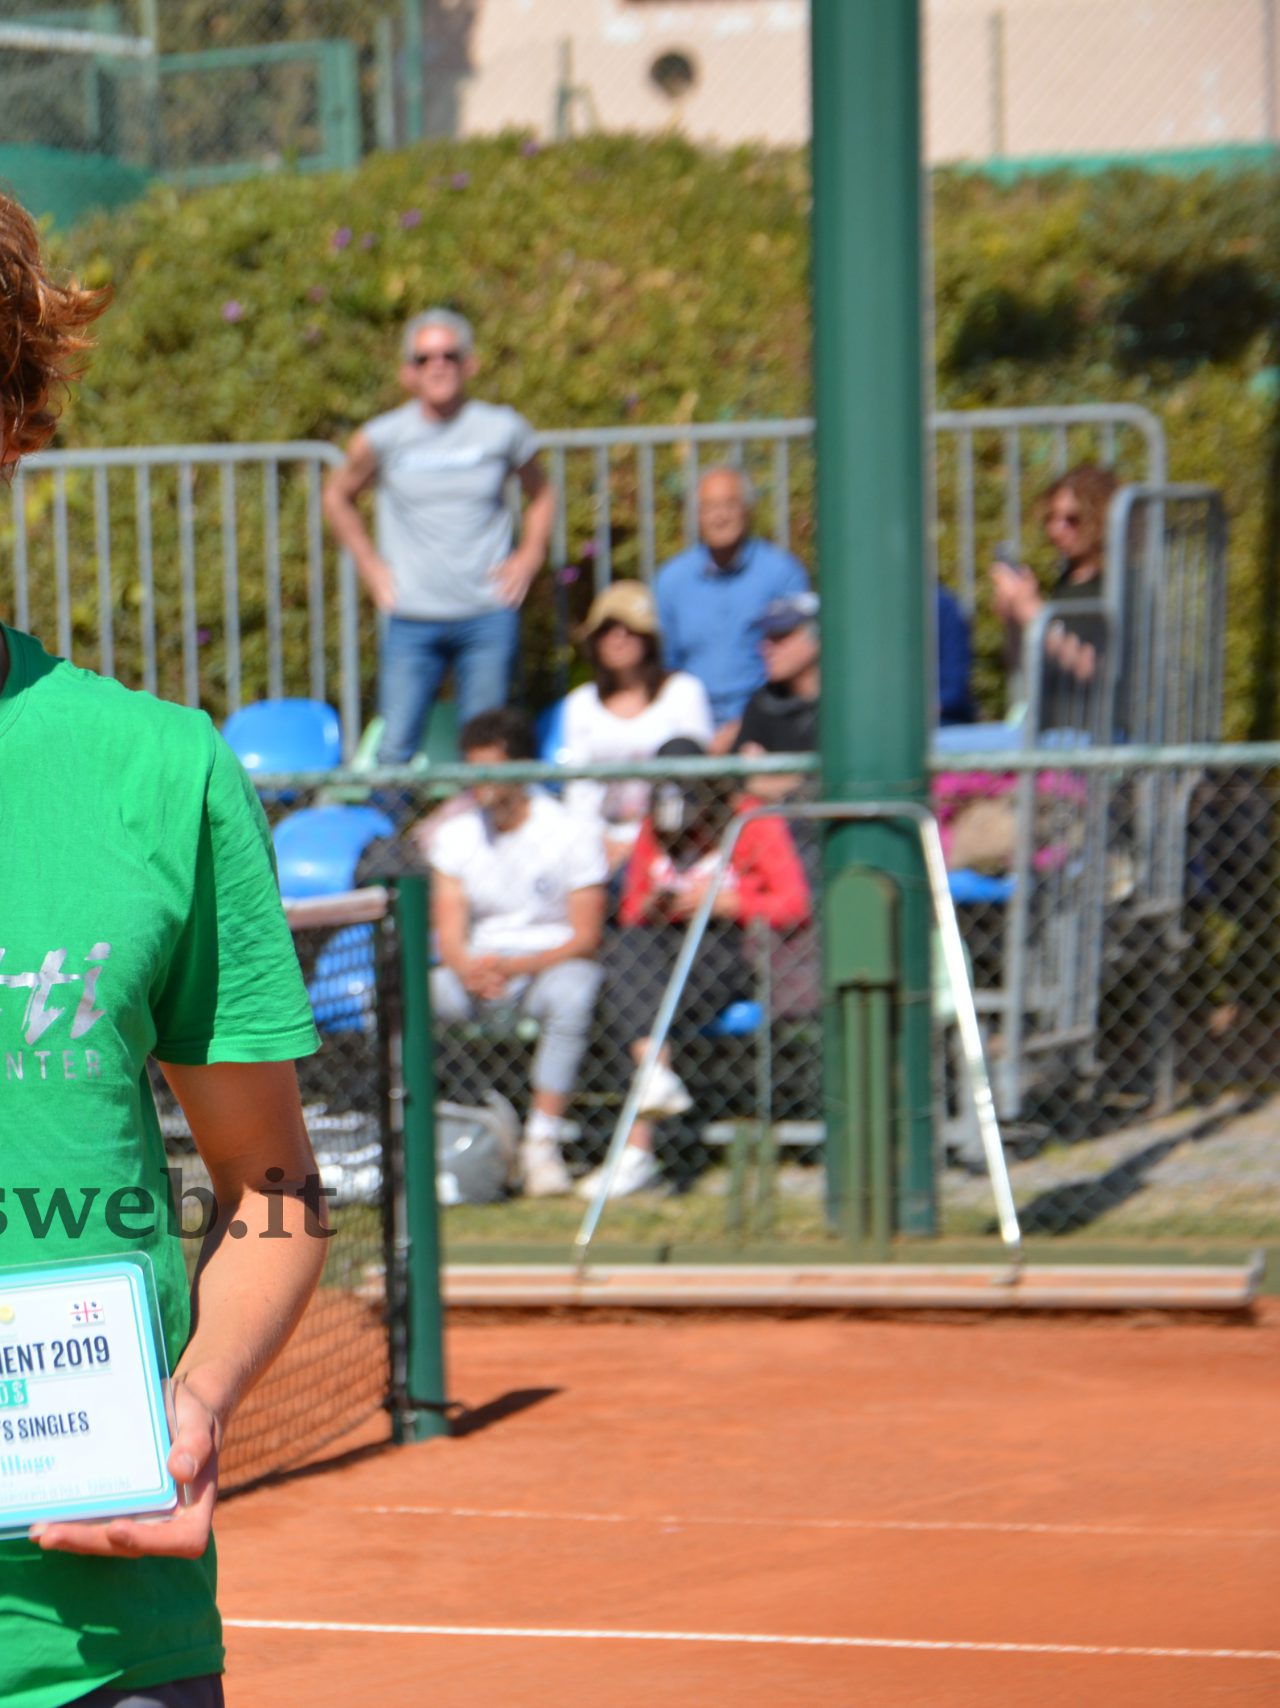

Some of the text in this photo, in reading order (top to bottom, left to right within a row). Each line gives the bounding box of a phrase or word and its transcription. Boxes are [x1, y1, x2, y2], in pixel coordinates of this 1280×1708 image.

[51, 1335, 111, 1369] 2019
[11, 1380, 25, 1405] $
[17, 1411, 90, 1438] SINGLES
